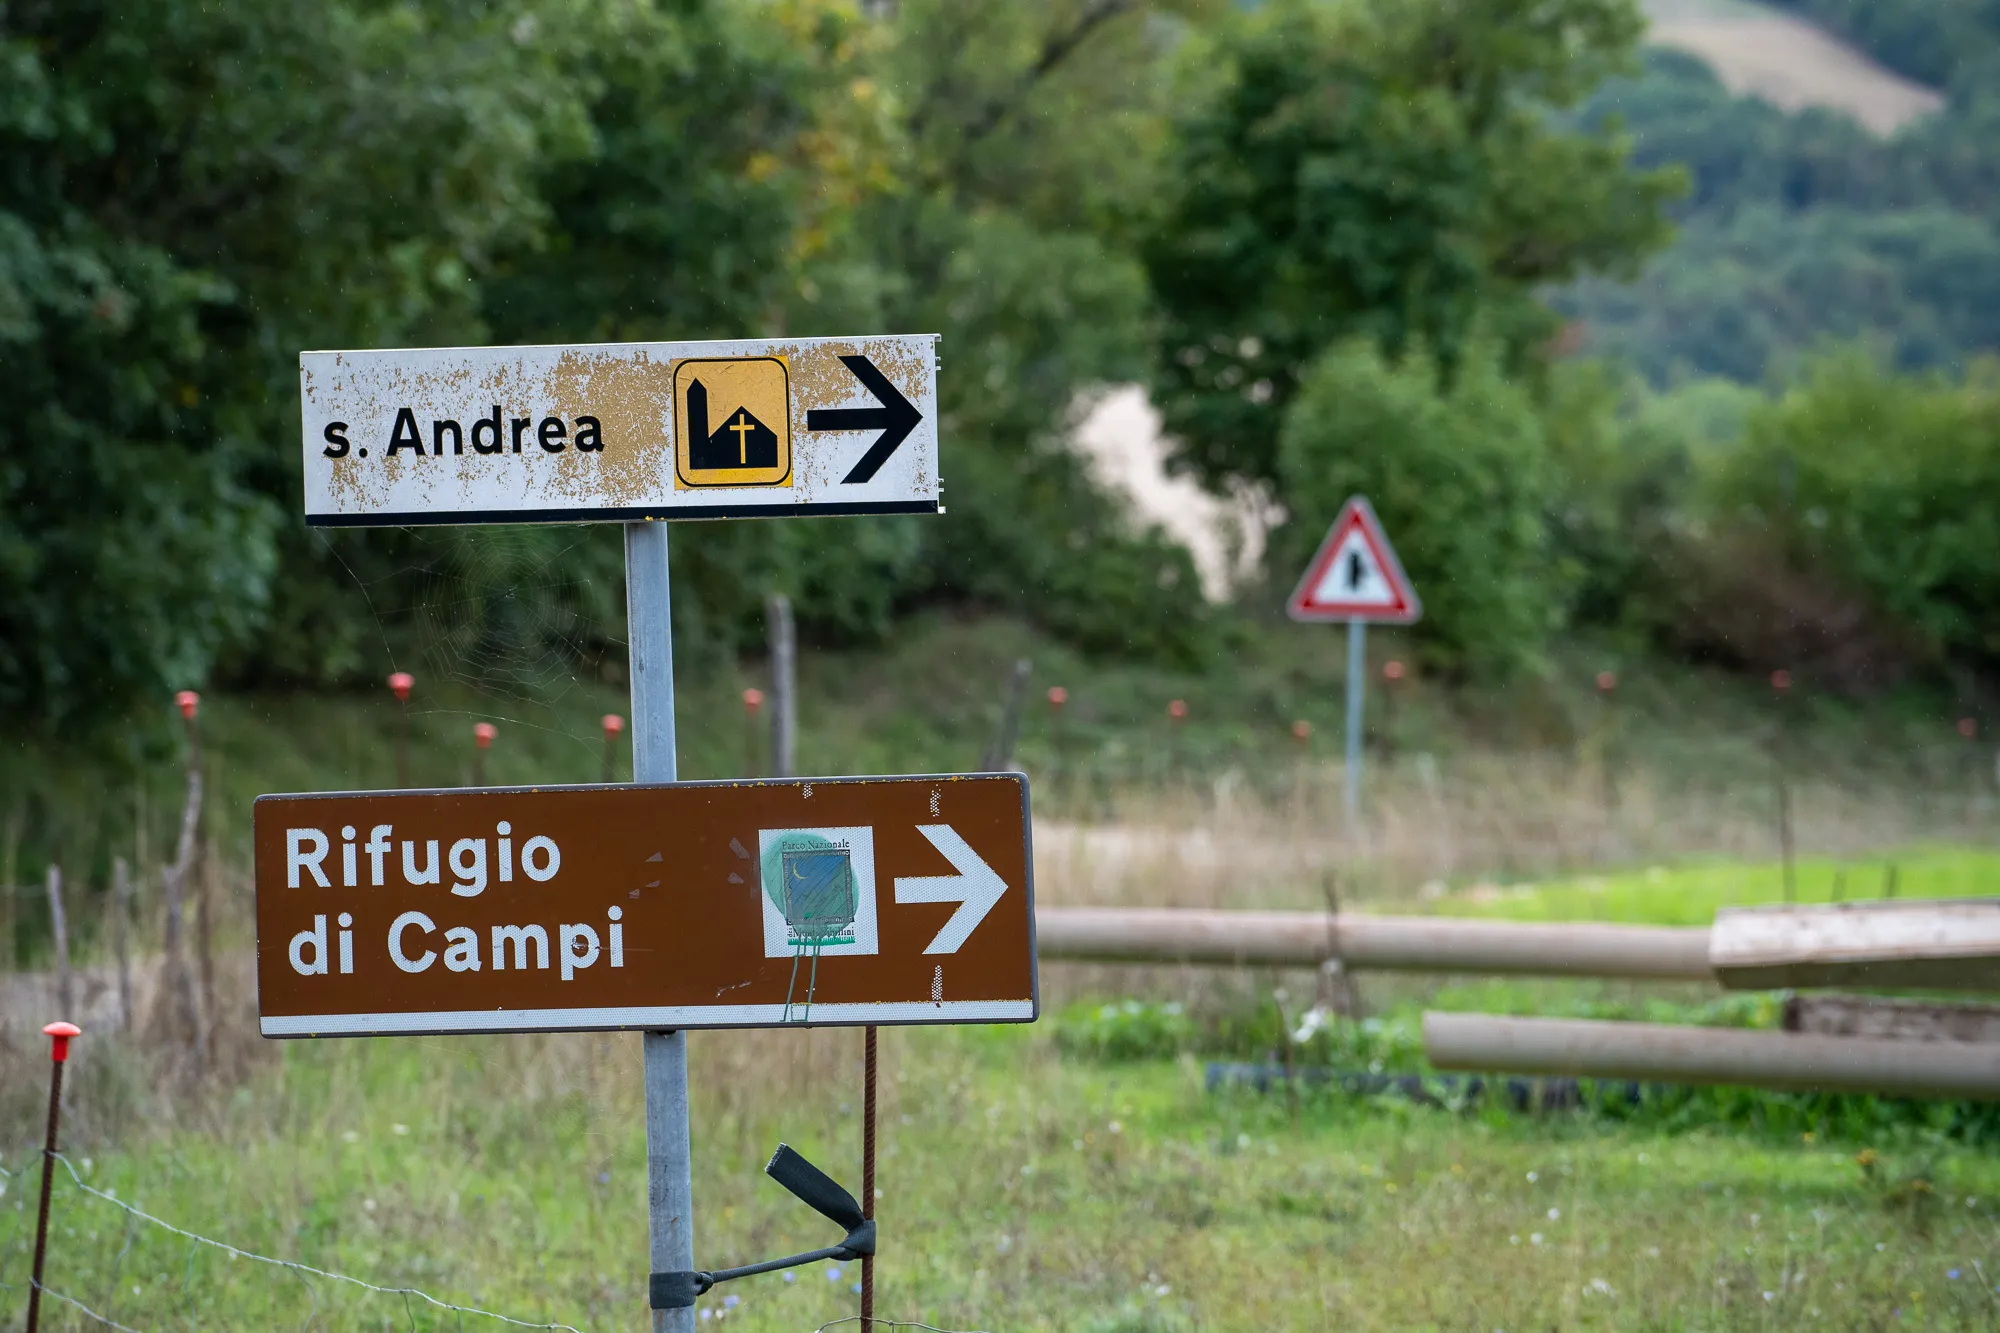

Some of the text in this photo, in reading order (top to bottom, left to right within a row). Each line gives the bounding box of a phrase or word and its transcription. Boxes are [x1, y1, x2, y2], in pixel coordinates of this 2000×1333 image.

[323, 404, 605, 459] s. Andrea
[286, 820, 561, 898] Rifugio
[782, 838, 850, 850] Parco Nazionale
[288, 905, 624, 981] di Campi
